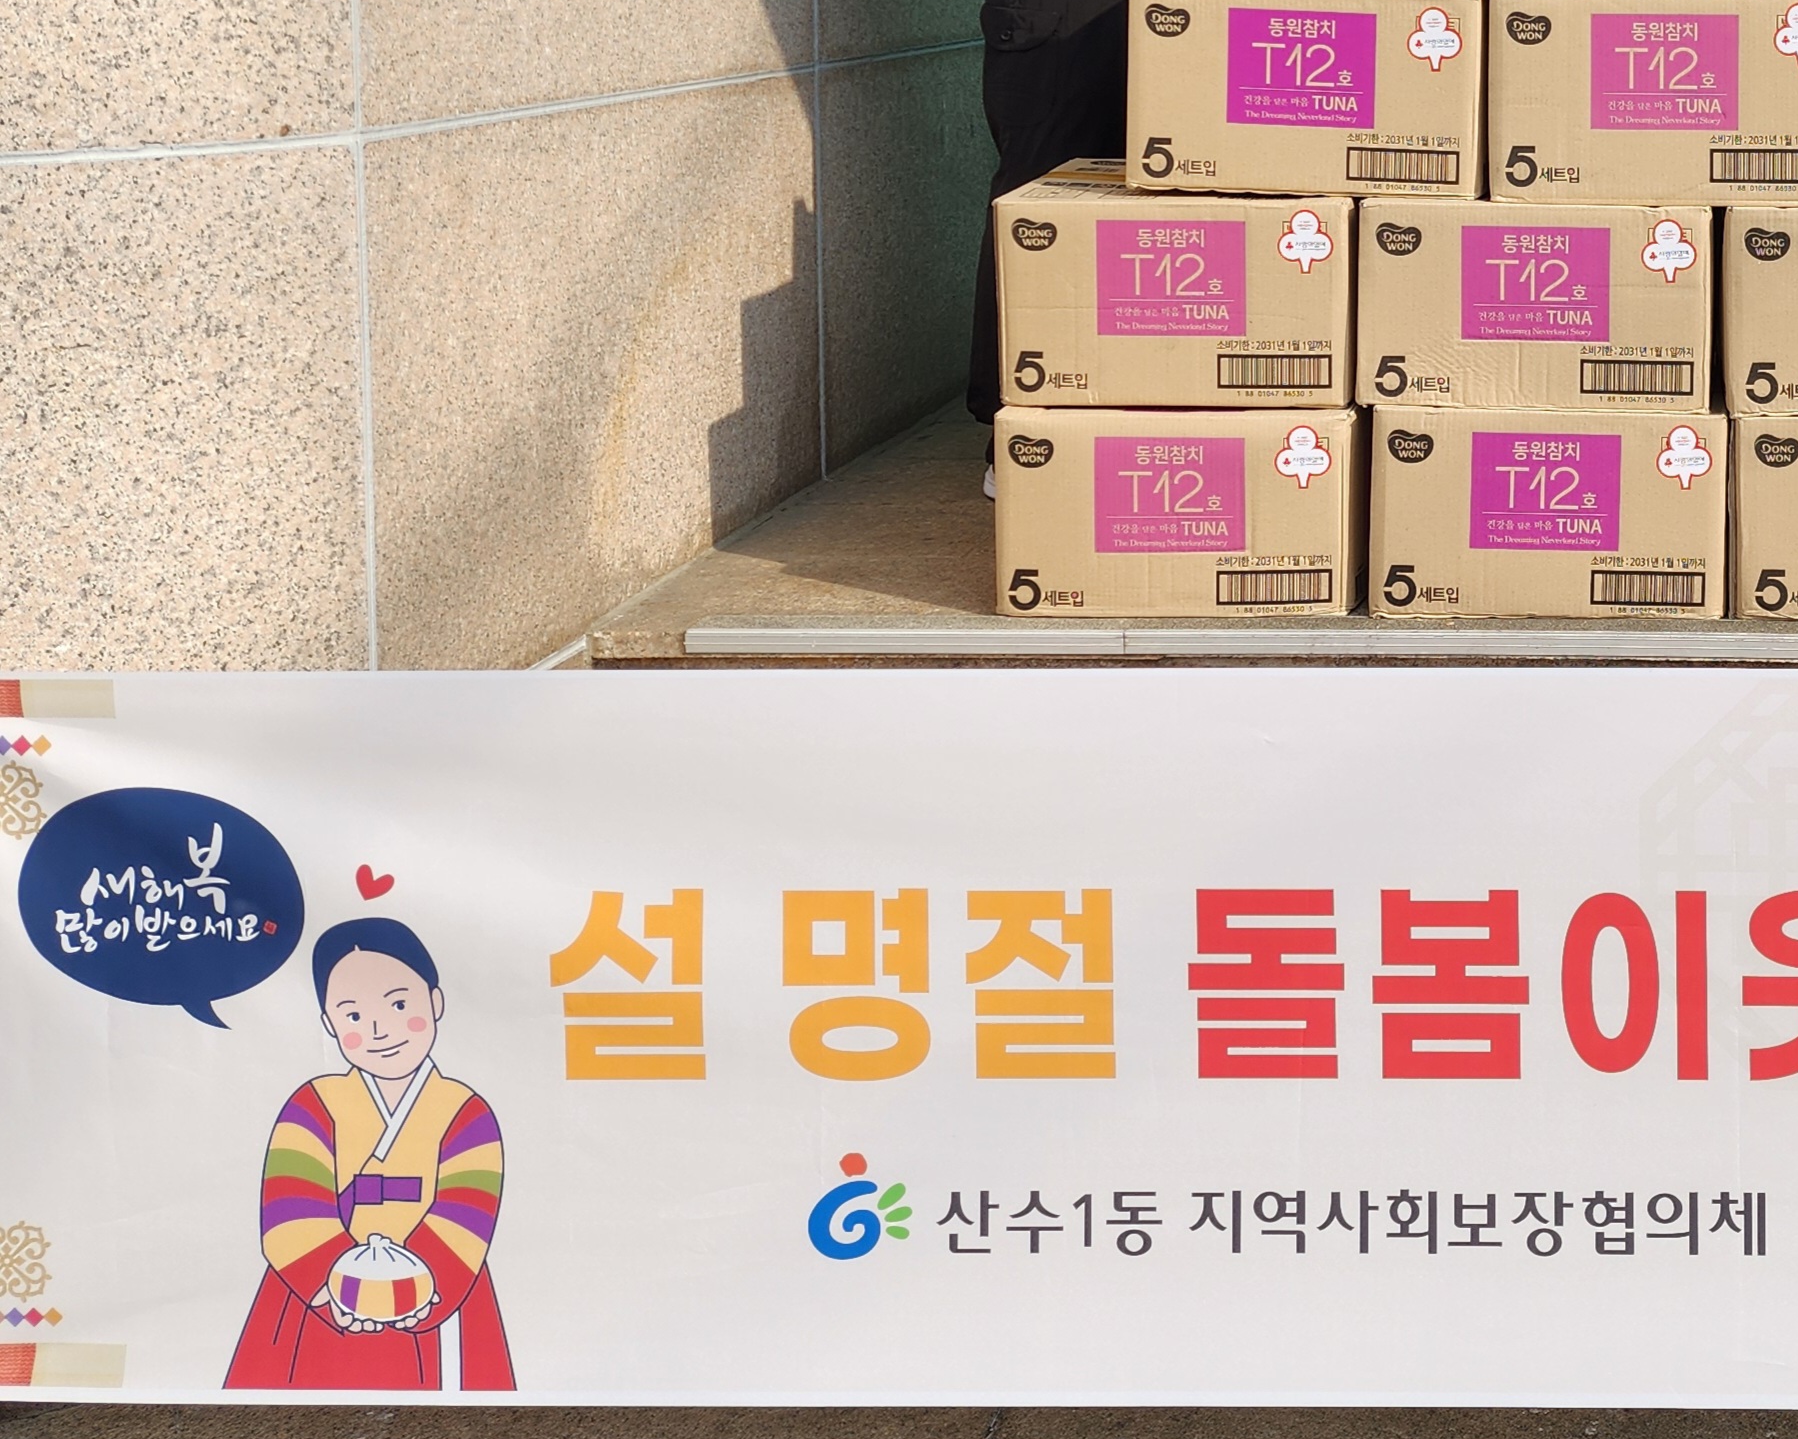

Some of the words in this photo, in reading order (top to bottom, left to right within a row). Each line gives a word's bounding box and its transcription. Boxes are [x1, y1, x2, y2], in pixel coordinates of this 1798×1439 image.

[1150, 11, 1186, 24] DONG
[1155, 23, 1182, 33] WON
[1268, 18, 1337, 40] 동원참치
[1630, 21, 1698, 42] 동원참치
[1312, 95, 1359, 112] TUNA
[1675, 99, 1722, 114] TUNA
[1244, 109, 1260, 119] The
[1335, 113, 1358, 124] Story
[1136, 227, 1206, 249] 동원참치
[1502, 234, 1569, 255] 동원참치
[1183, 305, 1229, 321] TUNA
[1547, 310, 1592, 325] TUNA
[1133, 444, 1204, 466] 동원참치
[1511, 440, 1581, 462] 동원참치
[1181, 520, 1228, 536] TUNA
[1555, 519, 1602, 535] TUNA
[549, 888, 707, 1081] 설
[781, 888, 1118, 1082] 명절
[935, 1186, 1164, 1256] 산수1동
[1190, 1186, 1772, 1259] 지역사회보장협의체
